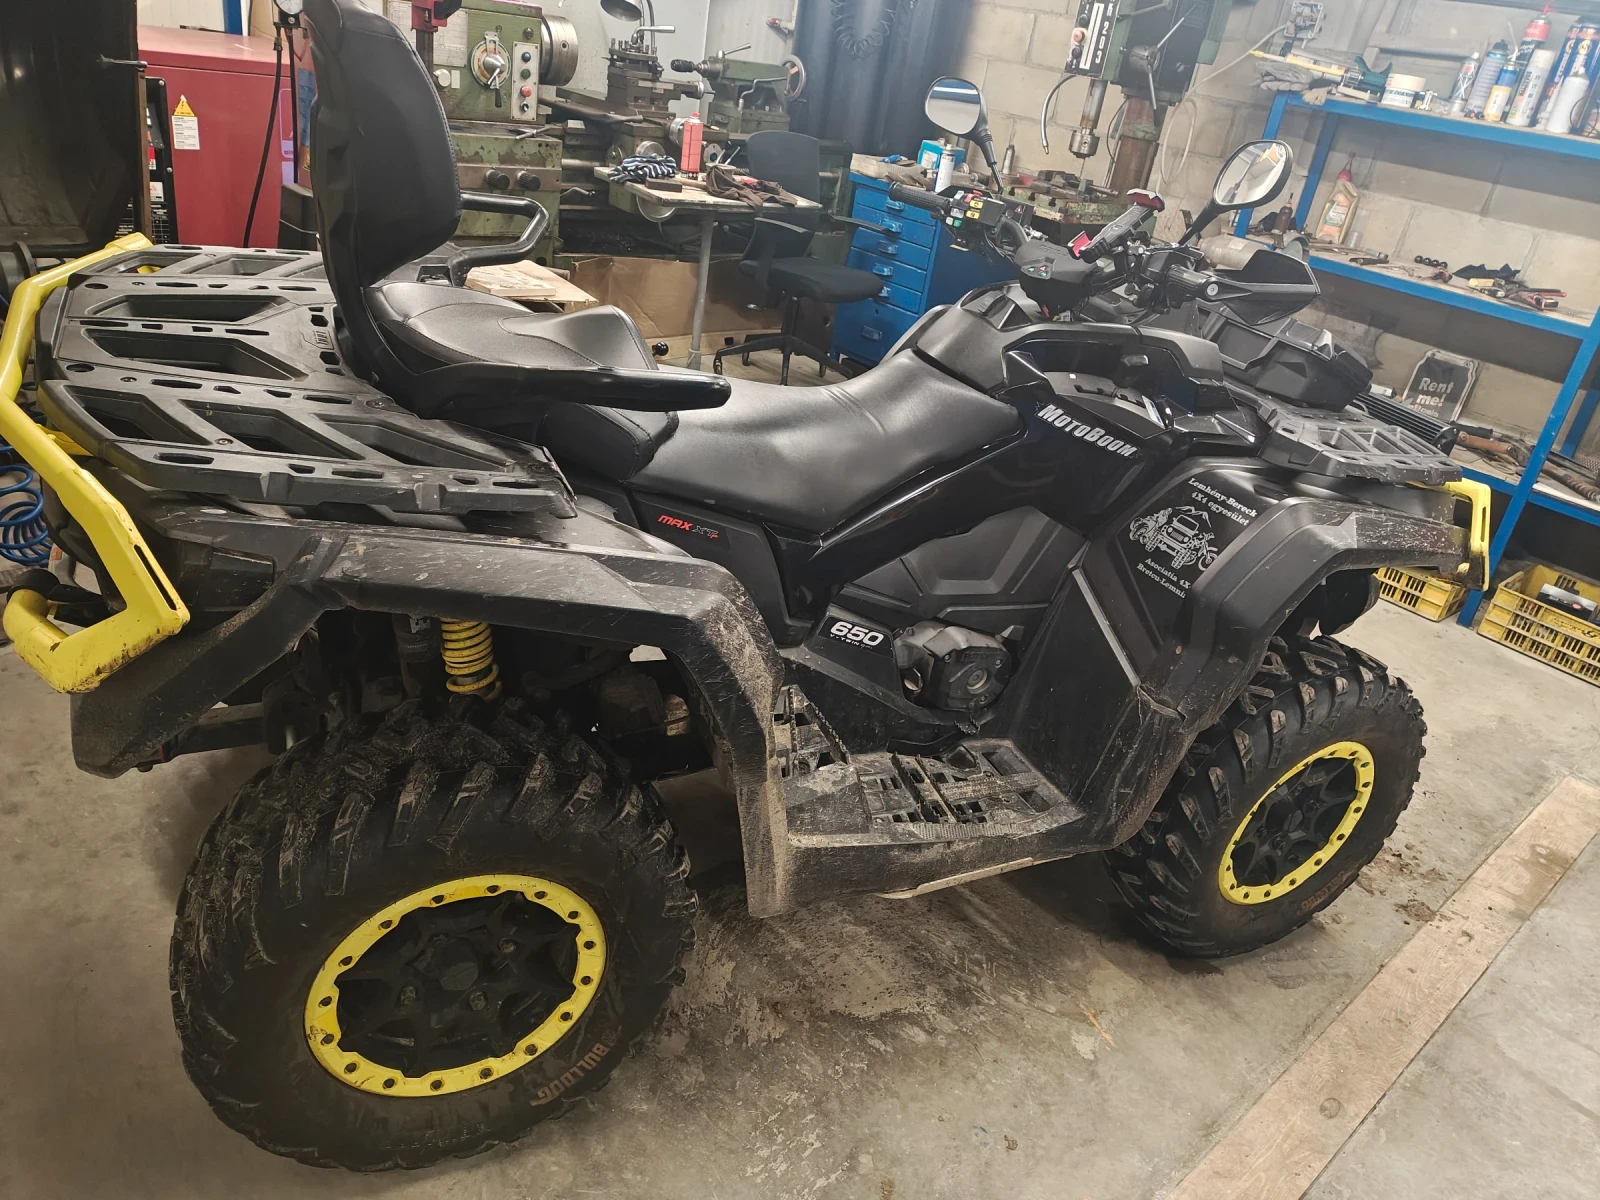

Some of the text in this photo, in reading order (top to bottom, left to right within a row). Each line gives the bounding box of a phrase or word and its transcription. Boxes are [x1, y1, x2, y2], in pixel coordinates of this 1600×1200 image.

[1418, 378, 1454, 394] Rent
[1416, 394, 1446, 407] me!
[1188, 477, 1257, 518] Lemhény-Bereck
[1191, 491, 1250, 526] 4X4 egyesület
[657, 514, 694, 531] MAX
[830, 621, 884, 646] 650
